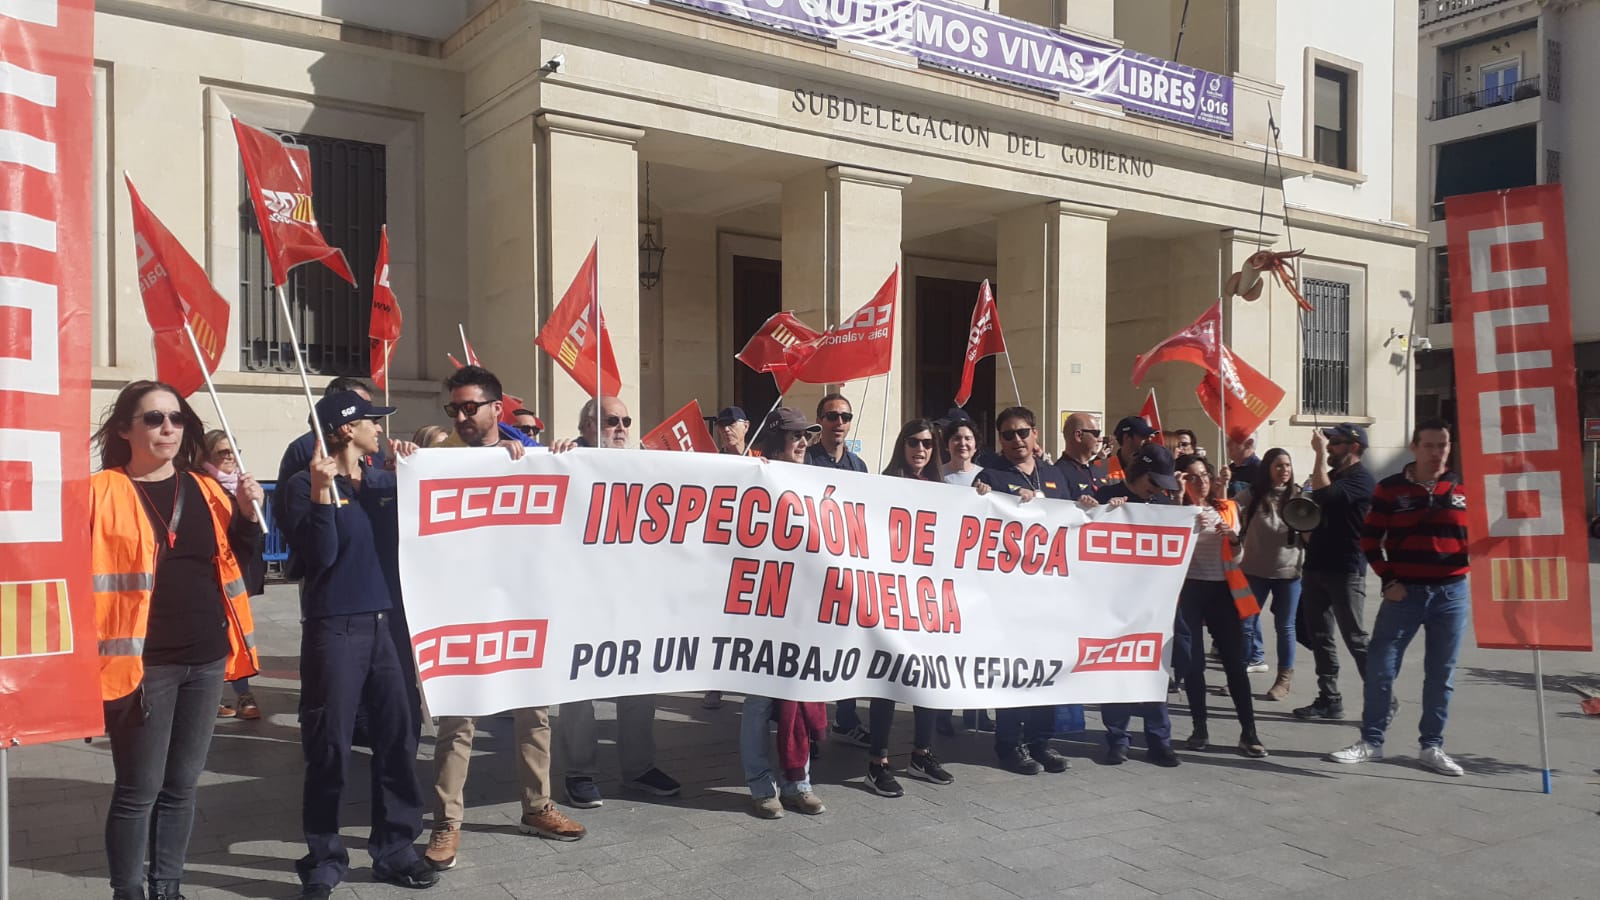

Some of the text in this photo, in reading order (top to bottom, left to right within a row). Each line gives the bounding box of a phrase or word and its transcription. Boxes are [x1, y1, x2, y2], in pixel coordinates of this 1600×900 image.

[998, 32, 1085, 82] VIVAS
[1119, 63, 1196, 110] LIBRES
[791, 89, 1154, 178] SUBDELEGACION DEL GOBIERNO
[1207, 99, 1229, 116] 016
[1468, 221, 1564, 537] CCOO
[429, 484, 558, 524] CCOO
[583, 482, 1069, 577] INSPECCIÓN DE PESCA
[1085, 529, 1184, 558] CCOO
[723, 558, 962, 634] EN HUELGA
[415, 629, 538, 673] CCOO
[569, 637, 1064, 690] POR UN TRABAJO DIGNO Y EFICAZ
[1080, 639, 1156, 666] CCOO
